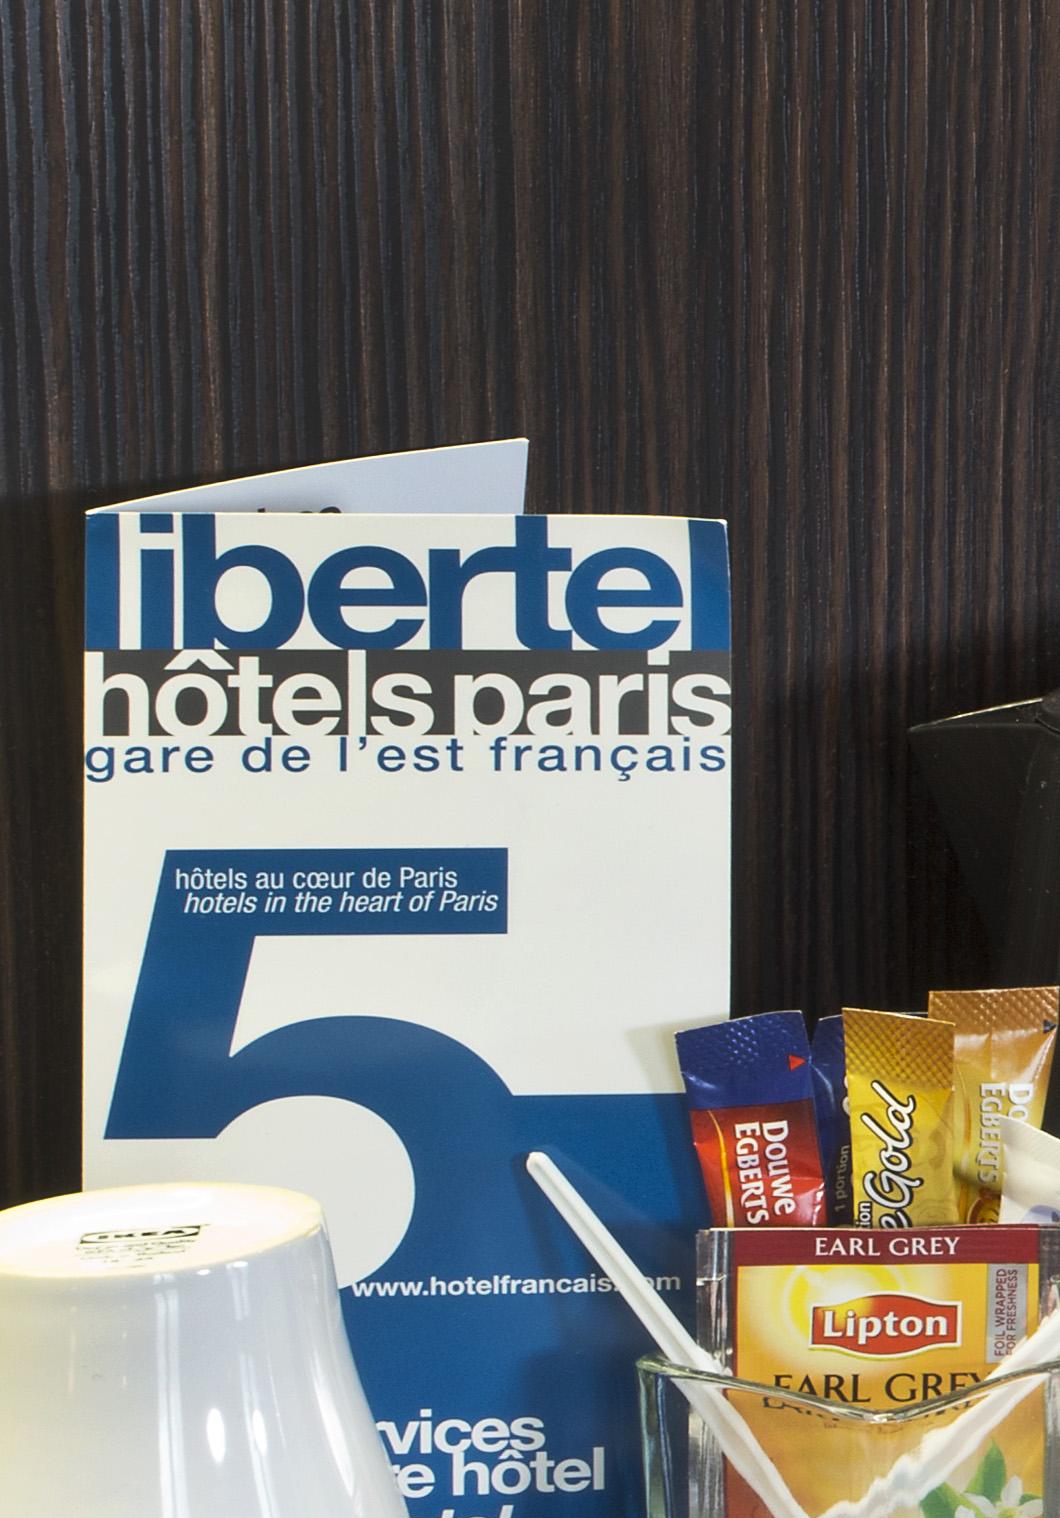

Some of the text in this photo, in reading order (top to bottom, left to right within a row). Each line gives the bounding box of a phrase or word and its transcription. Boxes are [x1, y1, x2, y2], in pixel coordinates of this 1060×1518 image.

[86, 513, 731, 651] libertel
[85, 649, 731, 737] hôtels paris
[85, 744, 214, 783] gare
[241, 736, 311, 773] de
[489, 736, 727, 782] français
[175, 867, 458, 890] hôtels au cœur de Paris
[183, 890, 499, 914] hotels in the heart of Paris
[734, 1121, 770, 1225] EGBERTS
[834, 1144, 851, 1212] 1 portion
[815, 1236, 960, 1256] EARL GREY
[822, 1310, 948, 1345] Lipton
[994, 1268, 1007, 1357] FOIL WRAPPED
[1006, 1268, 1018, 1331] FRESHNESS
[452, 1446, 605, 1496] hôtel
